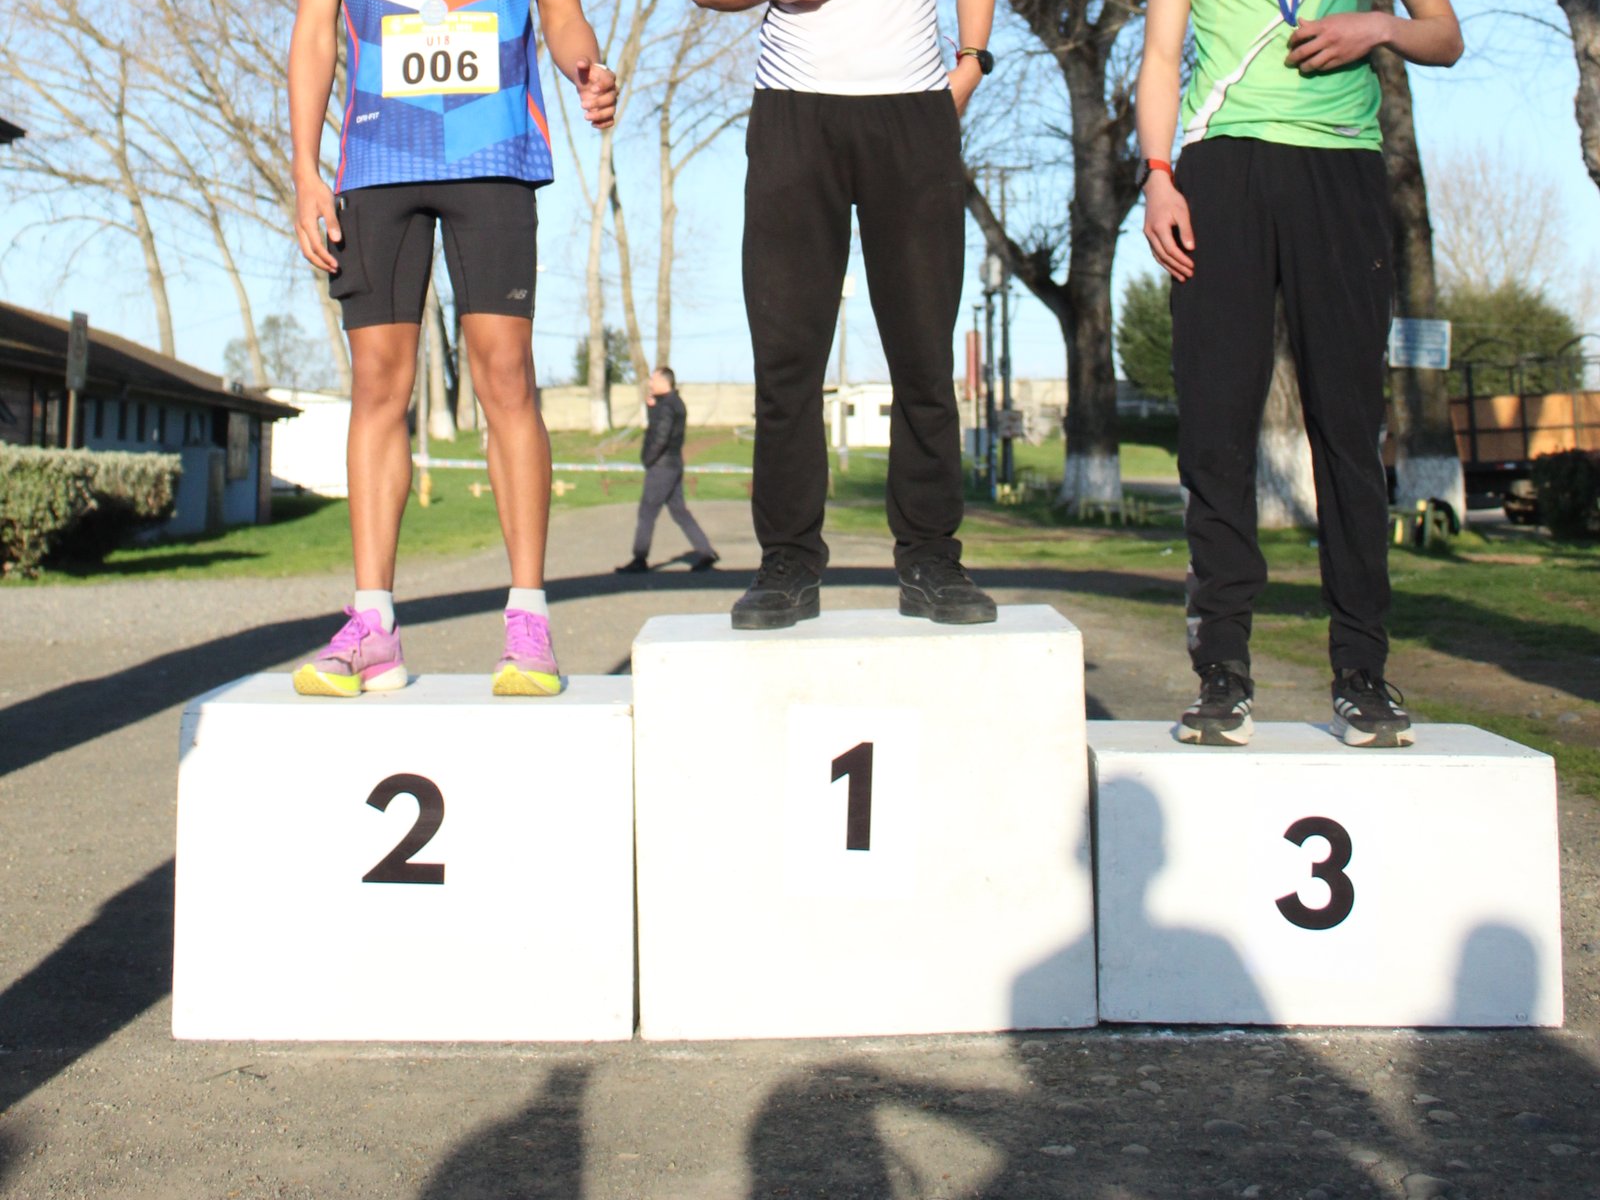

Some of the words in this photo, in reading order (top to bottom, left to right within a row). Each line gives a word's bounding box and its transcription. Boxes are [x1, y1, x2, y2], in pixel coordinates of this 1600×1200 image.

[402, 50, 479, 85] 006
[426, 35, 450, 47] U18
[362, 773, 445, 885] 2
[831, 742, 874, 851] 1
[1275, 816, 1355, 931] 3
